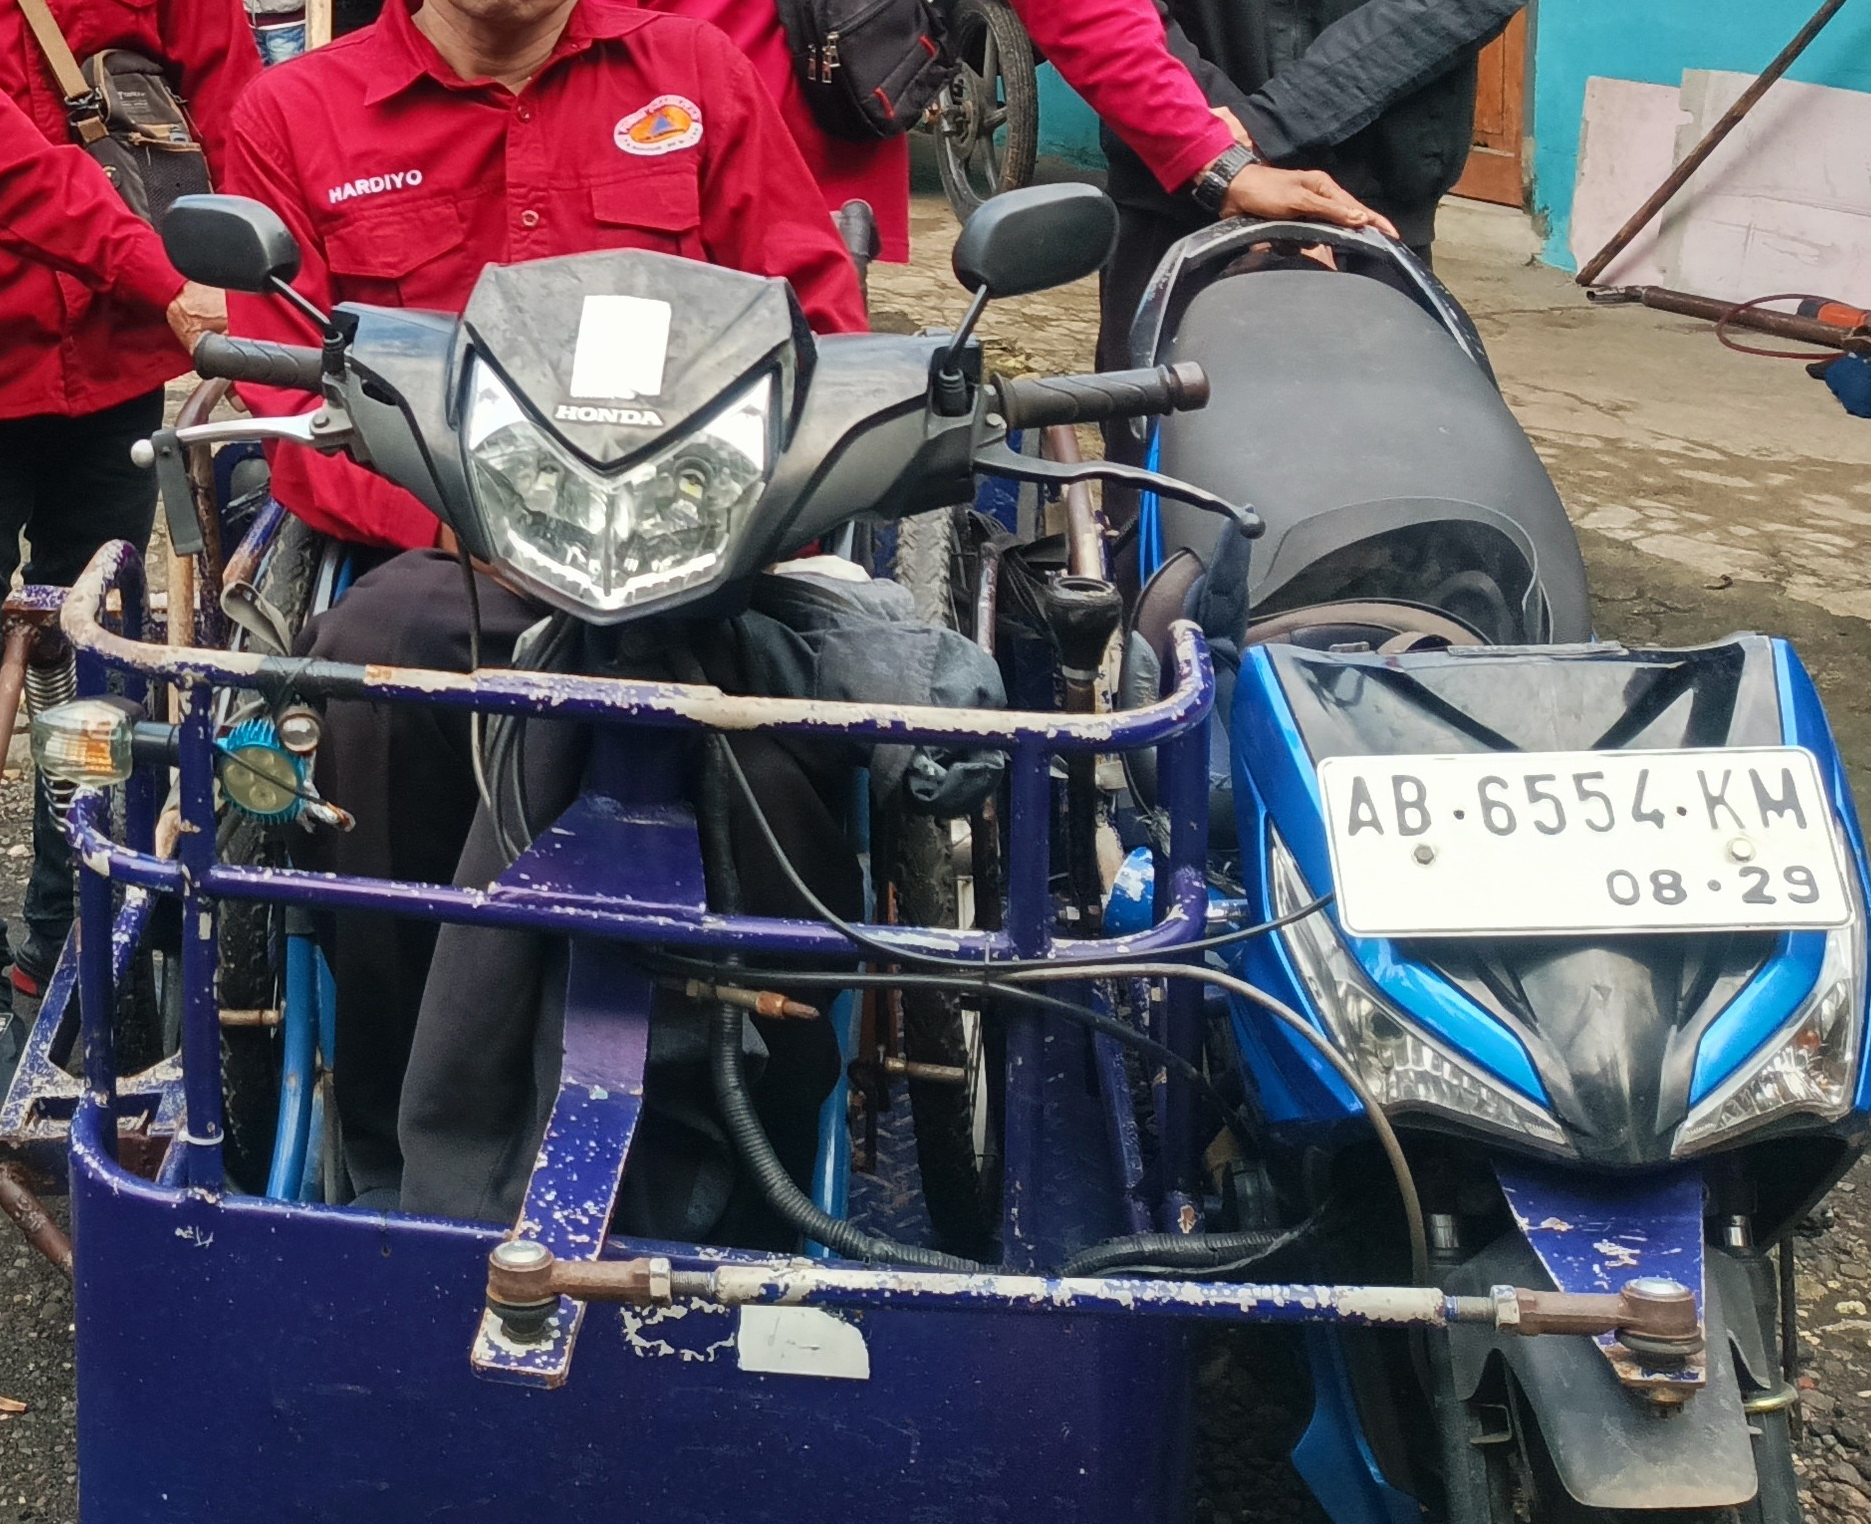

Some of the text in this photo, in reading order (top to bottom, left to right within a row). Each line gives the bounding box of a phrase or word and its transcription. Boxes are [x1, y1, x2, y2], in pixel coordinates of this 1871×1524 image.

[328, 169, 423, 204] HARDIYO
[554, 405, 664, 427] HONDA
[1347, 767, 1808, 836] AB 6554 KM
